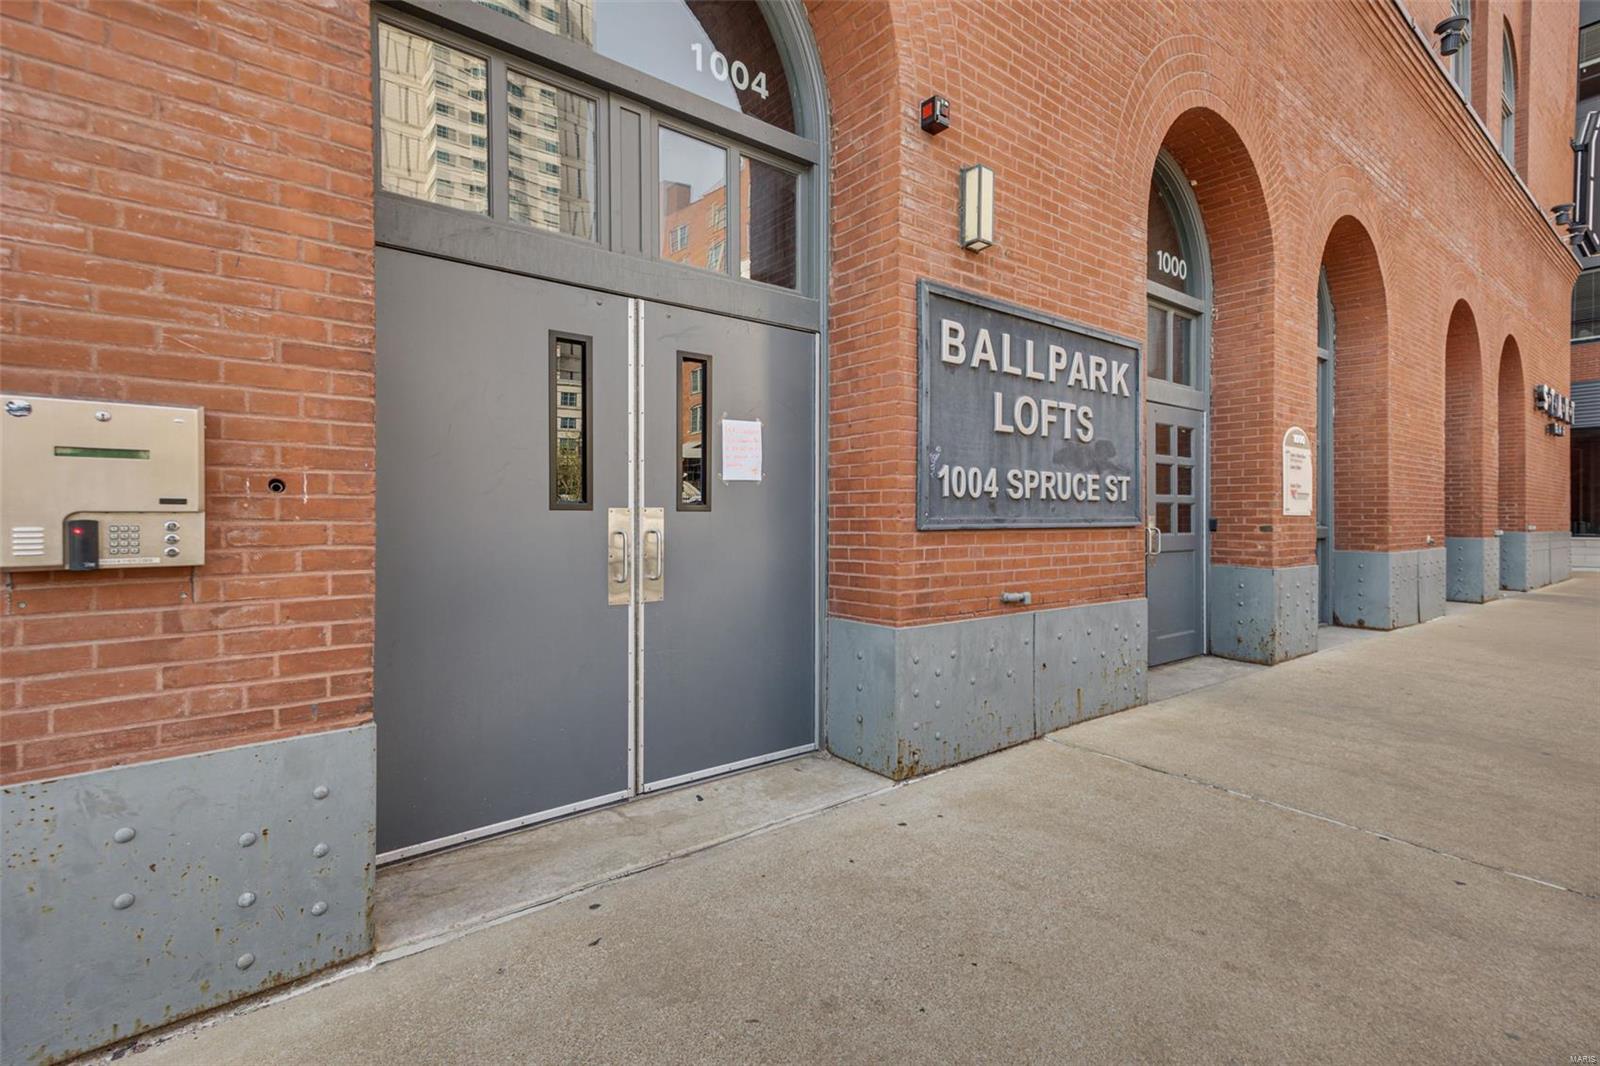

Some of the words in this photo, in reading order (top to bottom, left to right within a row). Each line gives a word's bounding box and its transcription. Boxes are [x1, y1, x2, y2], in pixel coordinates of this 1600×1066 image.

[691, 43, 769, 99] 1004
[1157, 250, 1187, 280] 1000
[940, 318, 1130, 398] BALLPARK
[993, 391, 1095, 443] LOFTS
[937, 464, 999, 499] 1004
[1006, 468, 1101, 501] SPRUCE
[1104, 475, 1131, 502] ST
